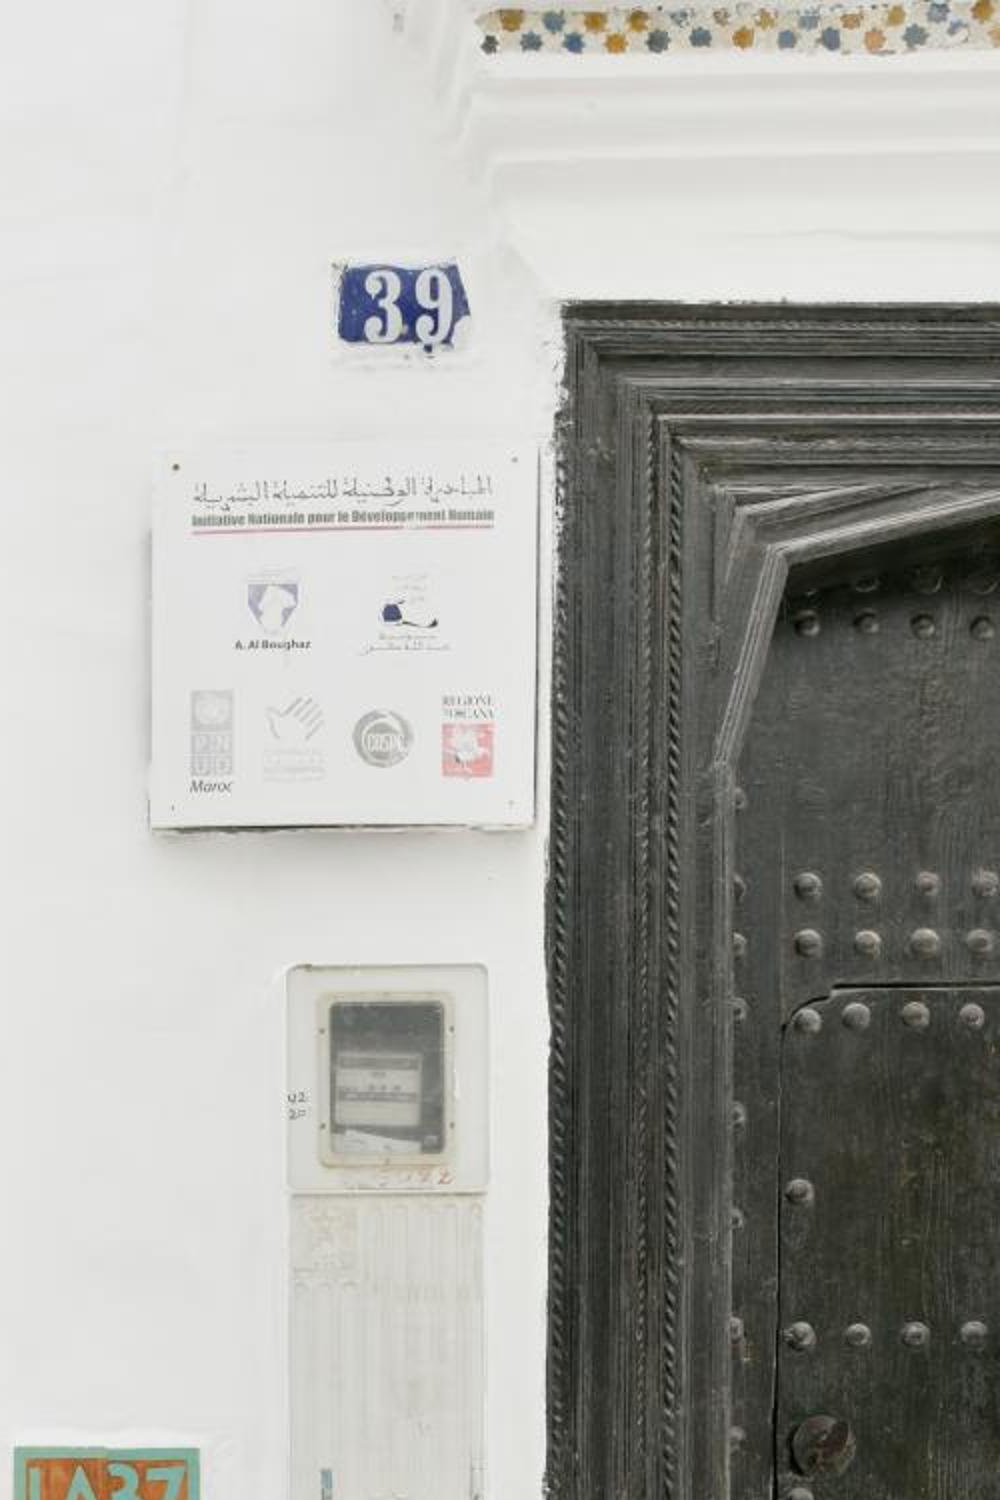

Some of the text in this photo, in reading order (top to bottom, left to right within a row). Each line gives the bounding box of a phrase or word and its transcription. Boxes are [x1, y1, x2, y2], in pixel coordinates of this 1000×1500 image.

[363, 268, 454, 344] 39
[191, 514, 245, 527] Initiative
[247, 512, 305, 525] Nationale
[307, 512, 335, 527] pour
[337, 510, 349, 522] le
[189, 779, 233, 793] Maroc
